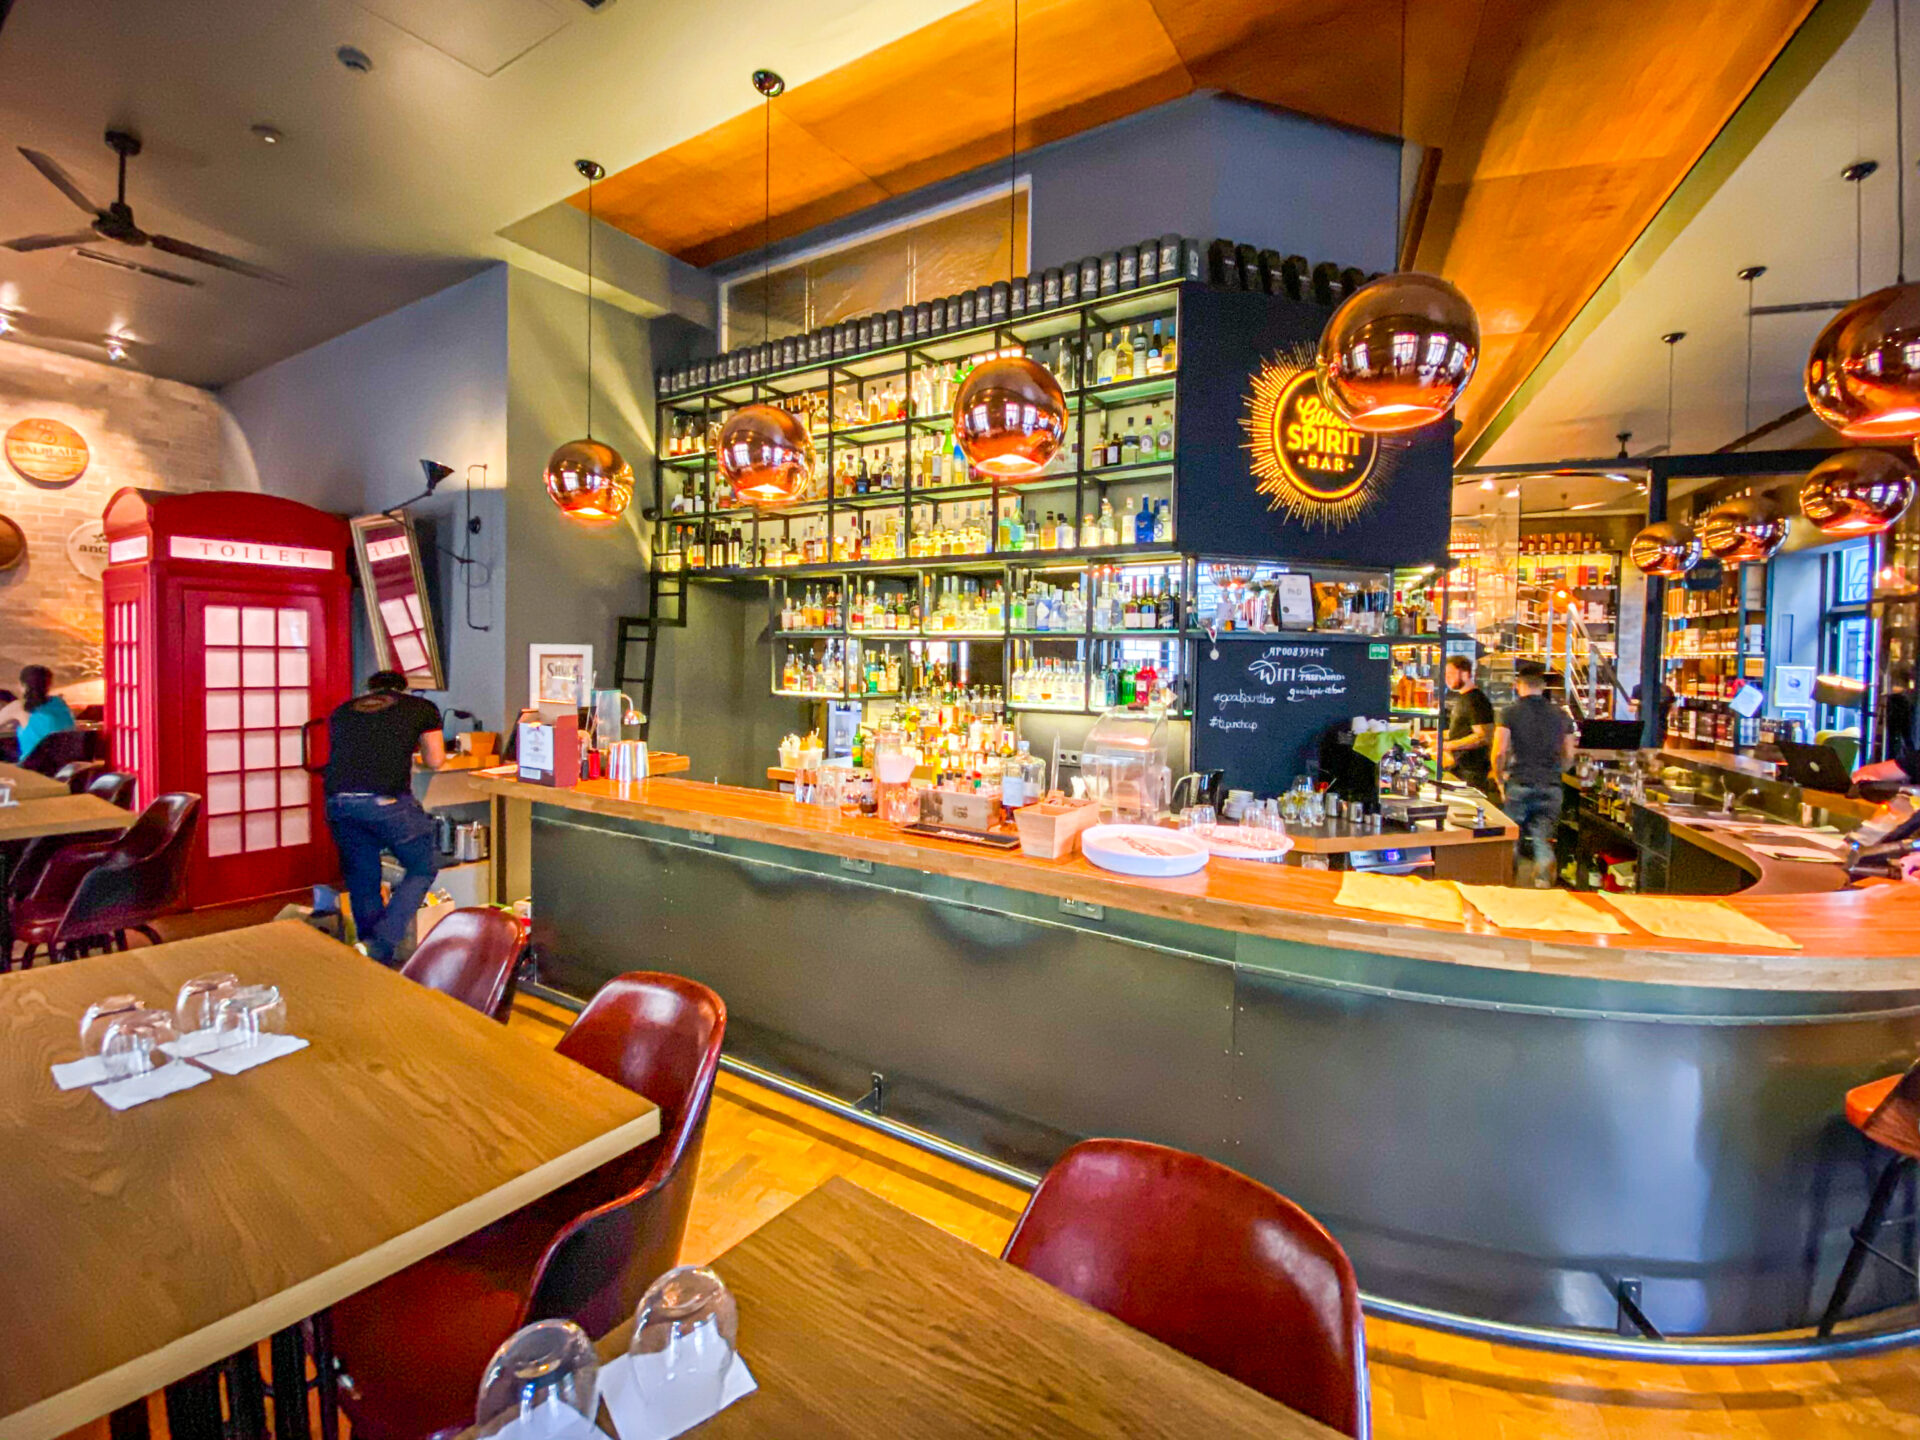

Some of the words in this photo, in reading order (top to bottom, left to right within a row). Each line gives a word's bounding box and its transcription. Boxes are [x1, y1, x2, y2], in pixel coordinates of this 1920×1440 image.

[1287, 422, 1365, 456] SPIRIT
[1307, 454, 1344, 472] BAR
[200, 541, 309, 564] TOILET
